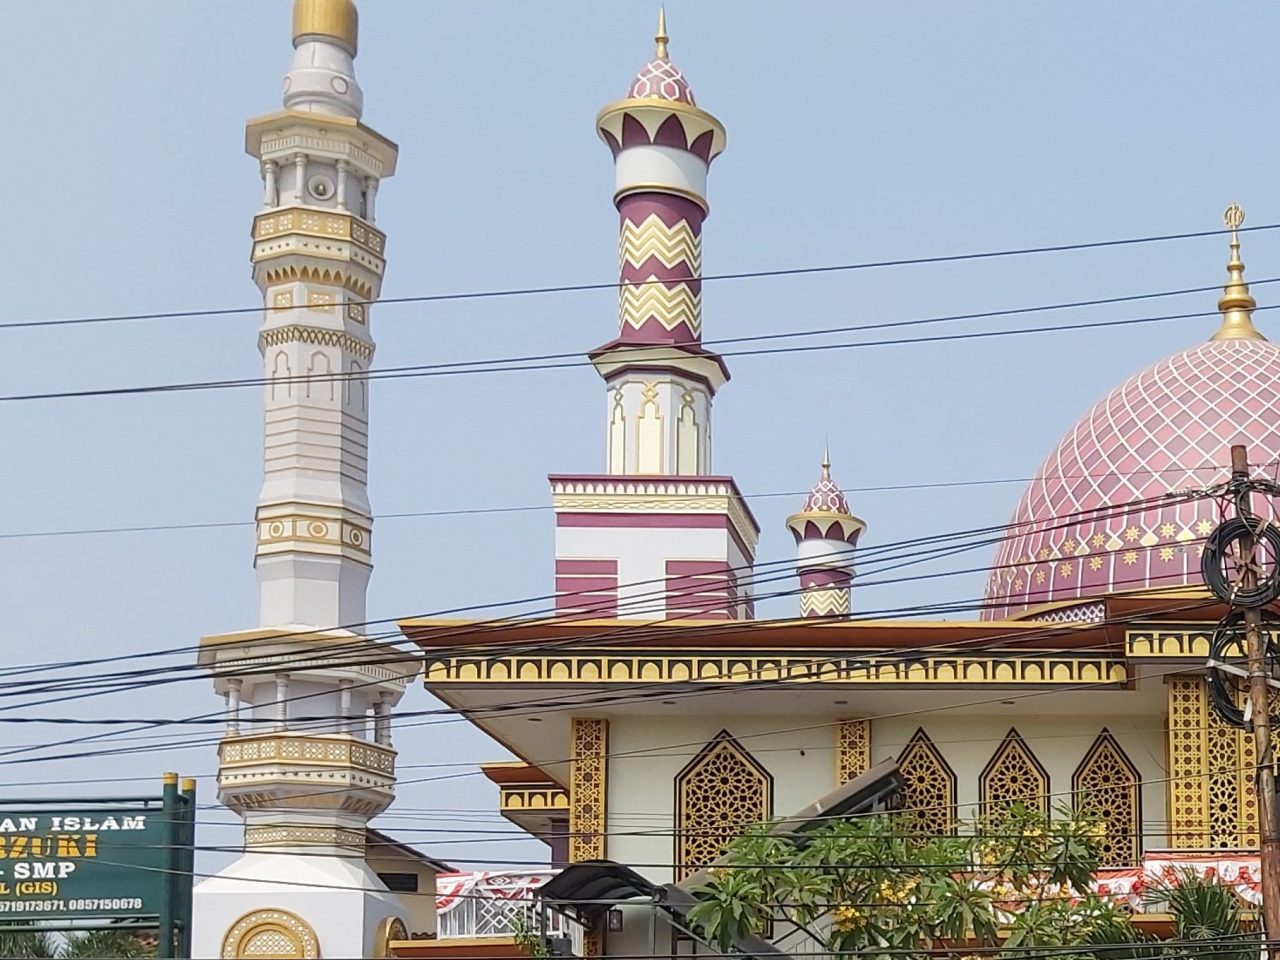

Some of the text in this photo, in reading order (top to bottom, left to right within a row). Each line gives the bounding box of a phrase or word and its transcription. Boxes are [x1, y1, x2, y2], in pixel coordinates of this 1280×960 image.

[0, 815, 146, 832] AN ISLAM
[14, 862, 75, 879] SMP
[15, 881, 58, 896] (GIS)
[68, 898, 142, 910] 0857150678
